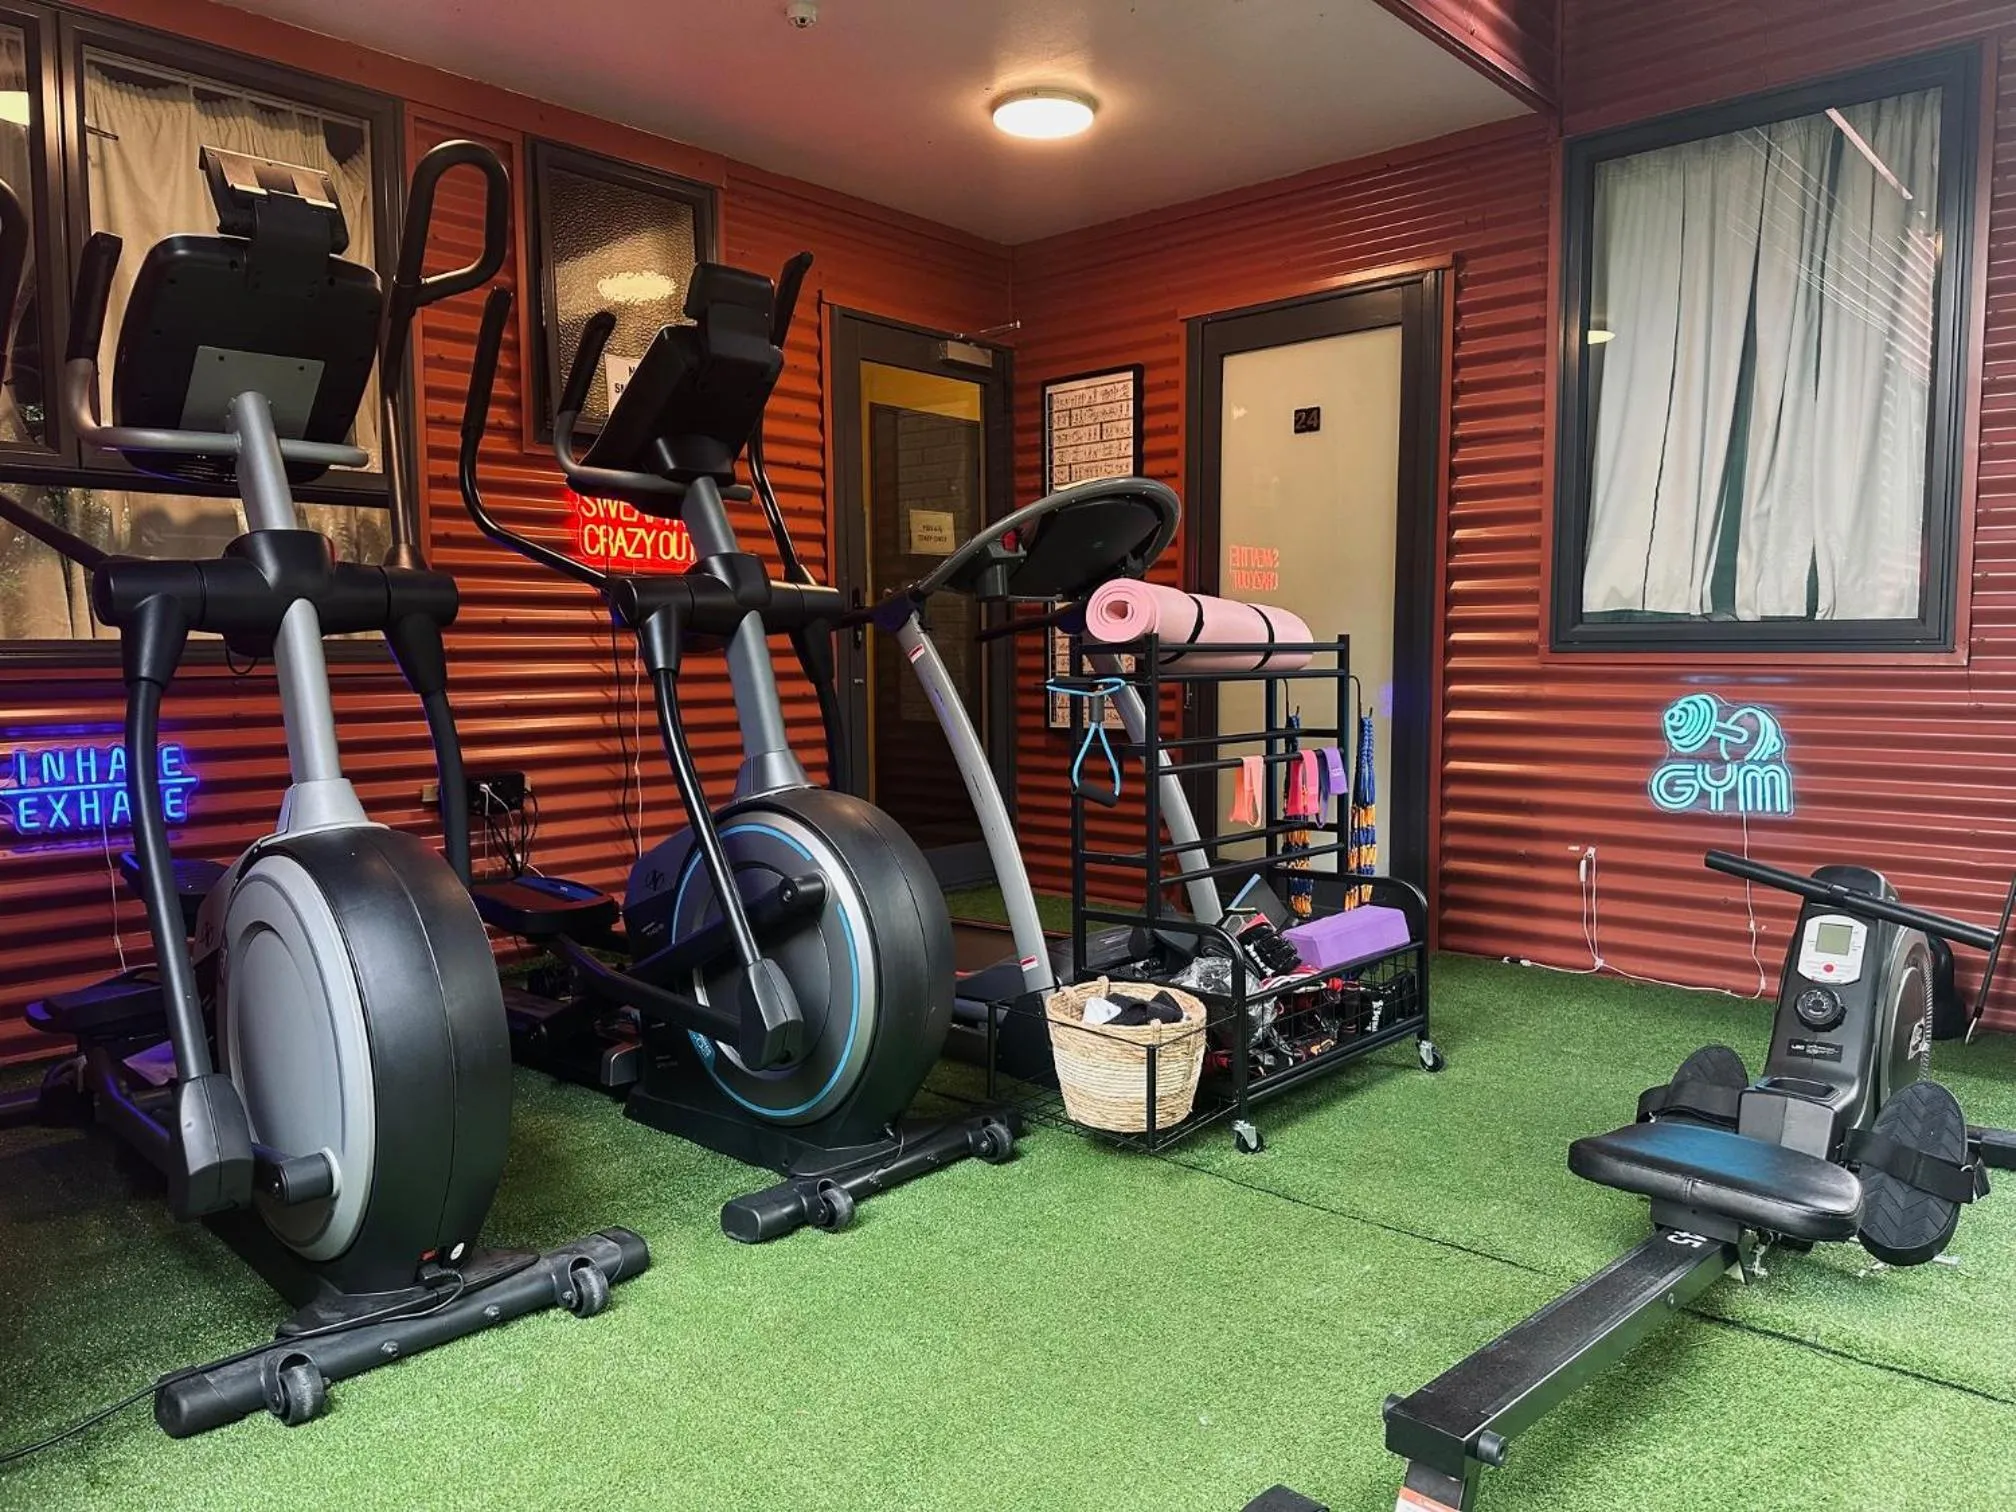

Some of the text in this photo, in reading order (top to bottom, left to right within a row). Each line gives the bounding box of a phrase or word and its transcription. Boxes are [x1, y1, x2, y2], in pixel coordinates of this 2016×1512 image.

[1294, 410, 1319, 430] 24
[583, 524, 657, 560] CRAZY
[18, 746, 183, 786] INHAE
[18, 787, 186, 829] EXHAE
[1651, 763, 1789, 813] GYM
